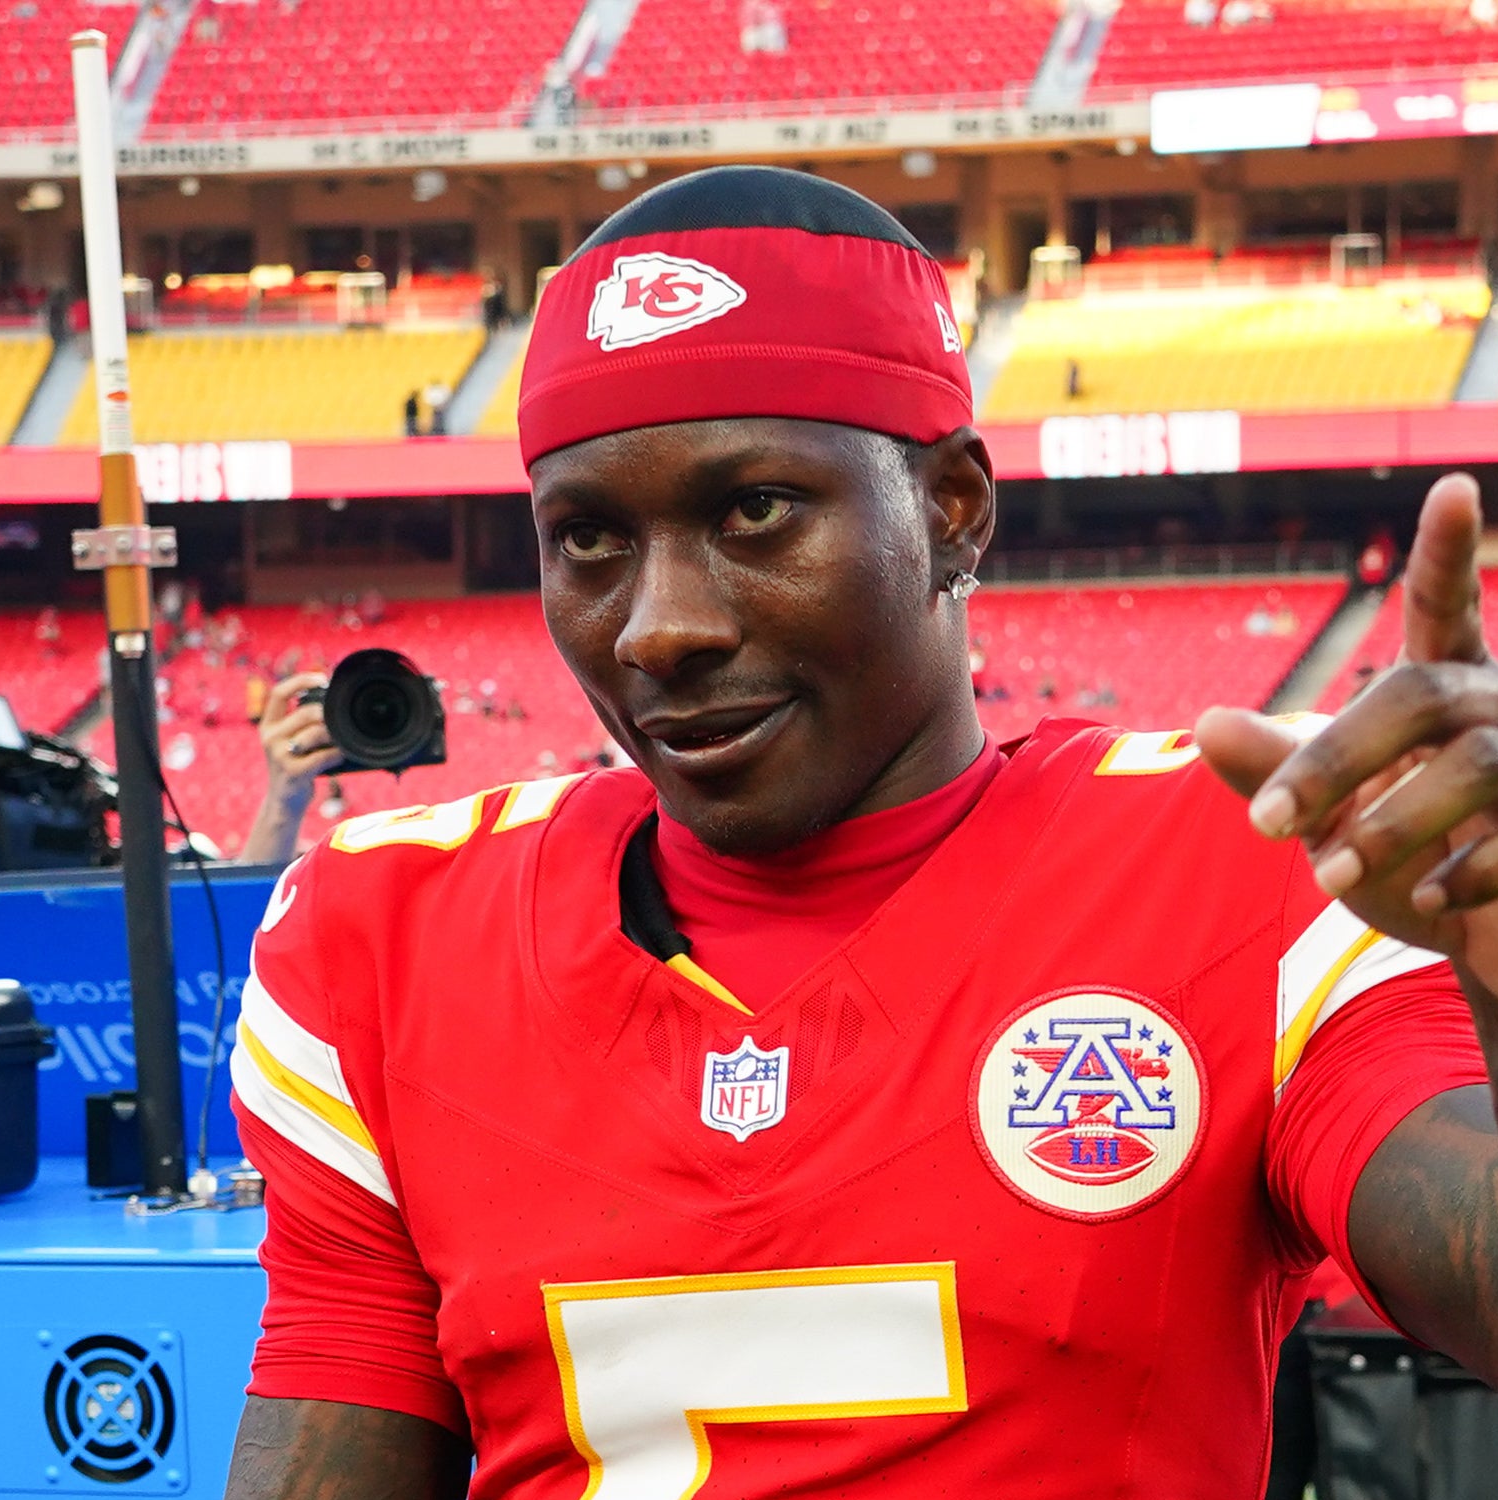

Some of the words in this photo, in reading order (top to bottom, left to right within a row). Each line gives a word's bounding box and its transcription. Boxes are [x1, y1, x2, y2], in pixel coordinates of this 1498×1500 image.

[622, 272, 704, 318] KC
[716, 1085, 771, 1121] NFL
[1067, 1138, 1120, 1166] LH
